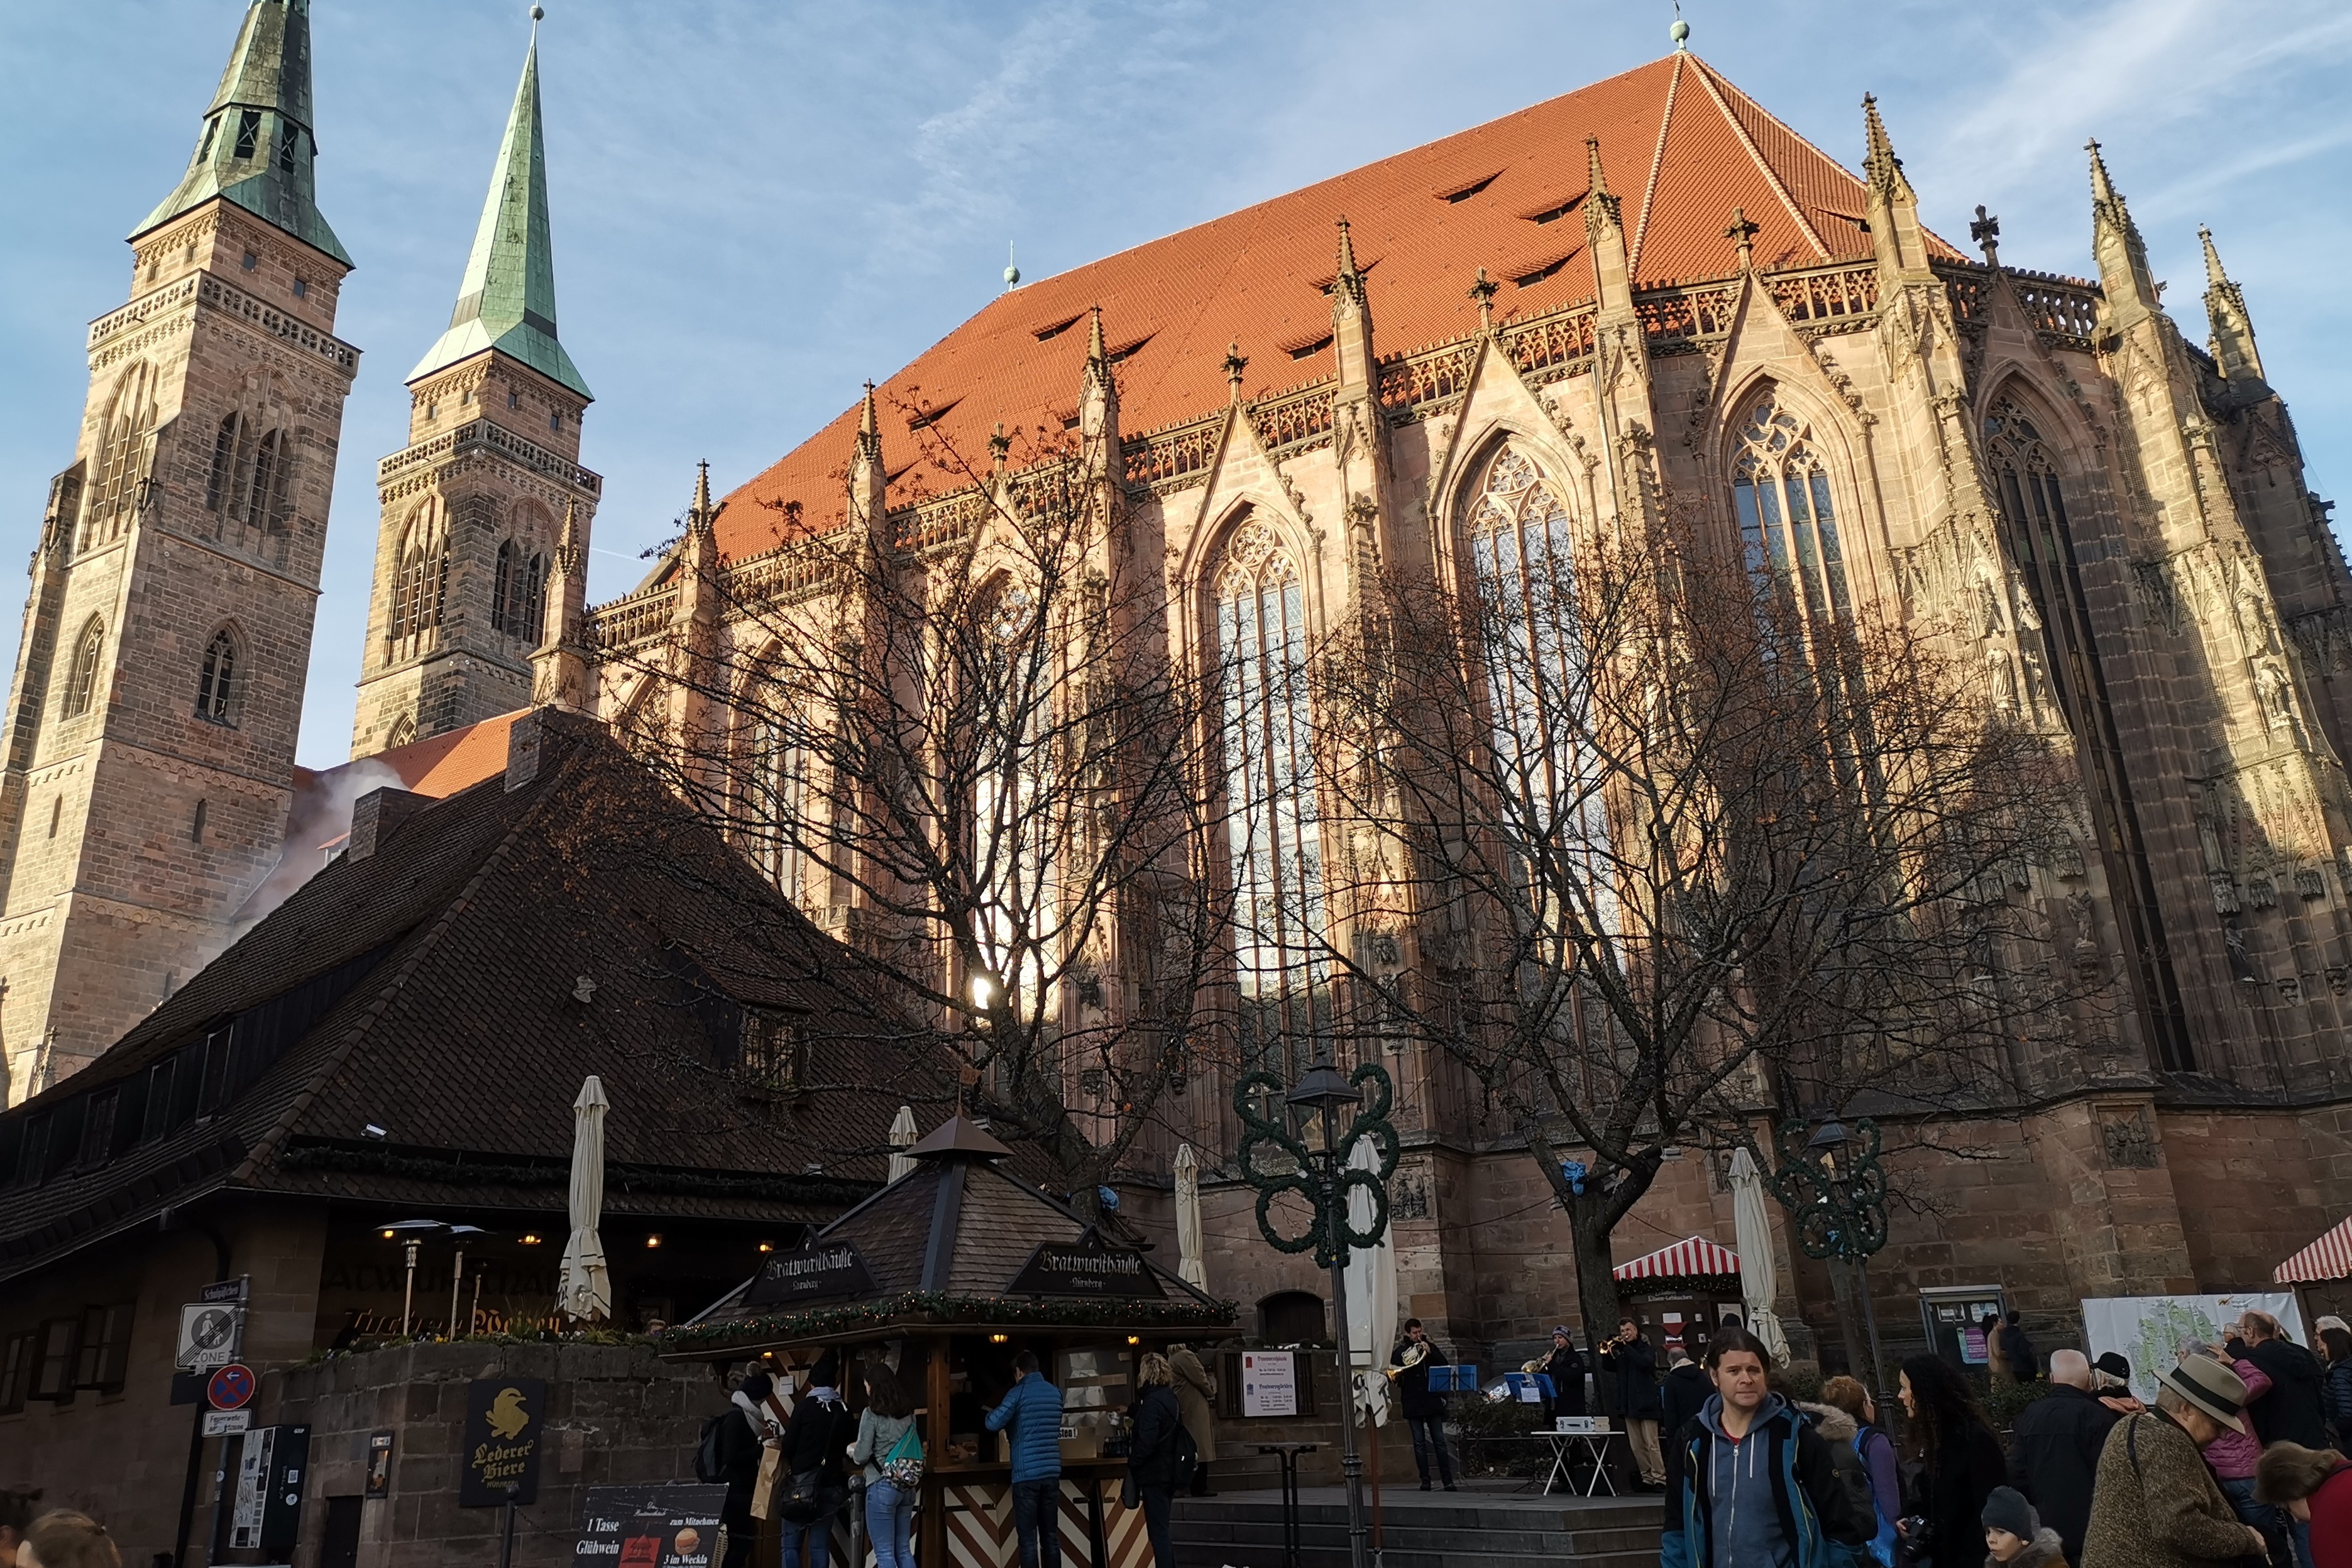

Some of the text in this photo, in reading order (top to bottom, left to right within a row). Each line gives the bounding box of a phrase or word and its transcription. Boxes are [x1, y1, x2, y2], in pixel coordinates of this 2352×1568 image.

[1072, 1277, 1102, 1290] Nürnberg
[193, 1351, 225, 1363] ZONE
[471, 1439, 534, 1468] Lederer
[481, 1461, 525, 1483] Biere
[594, 1518, 619, 1532] Tasse
[576, 1540, 620, 1554] Glühwein
[670, 1554, 680, 1564] im
